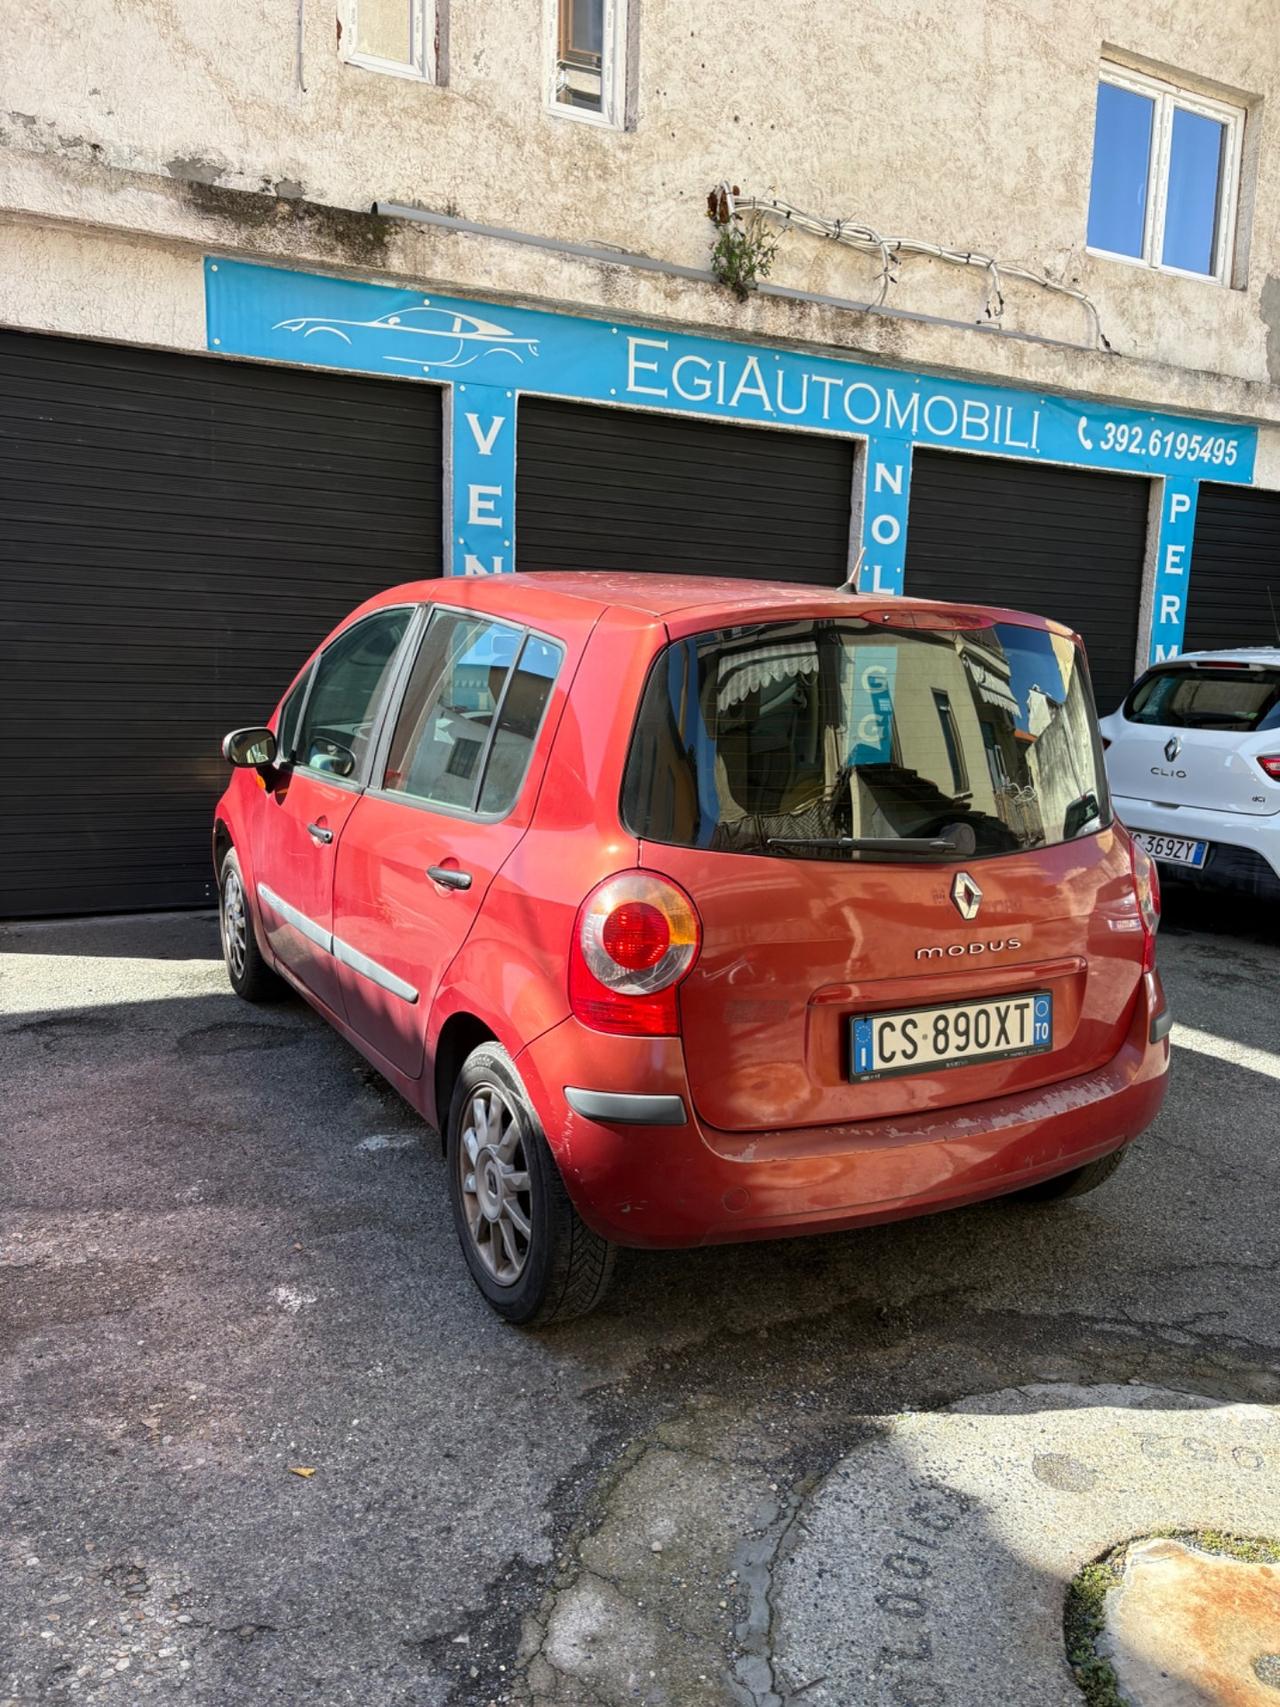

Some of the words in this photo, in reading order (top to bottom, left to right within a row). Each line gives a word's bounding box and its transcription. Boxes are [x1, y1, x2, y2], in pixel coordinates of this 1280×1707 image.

[1100, 422, 1238, 466] 392.6195495
[1150, 766, 1187, 778] CLIO
[915, 936, 1023, 960] MODUS
[1035, 1022, 1048, 1041] TO
